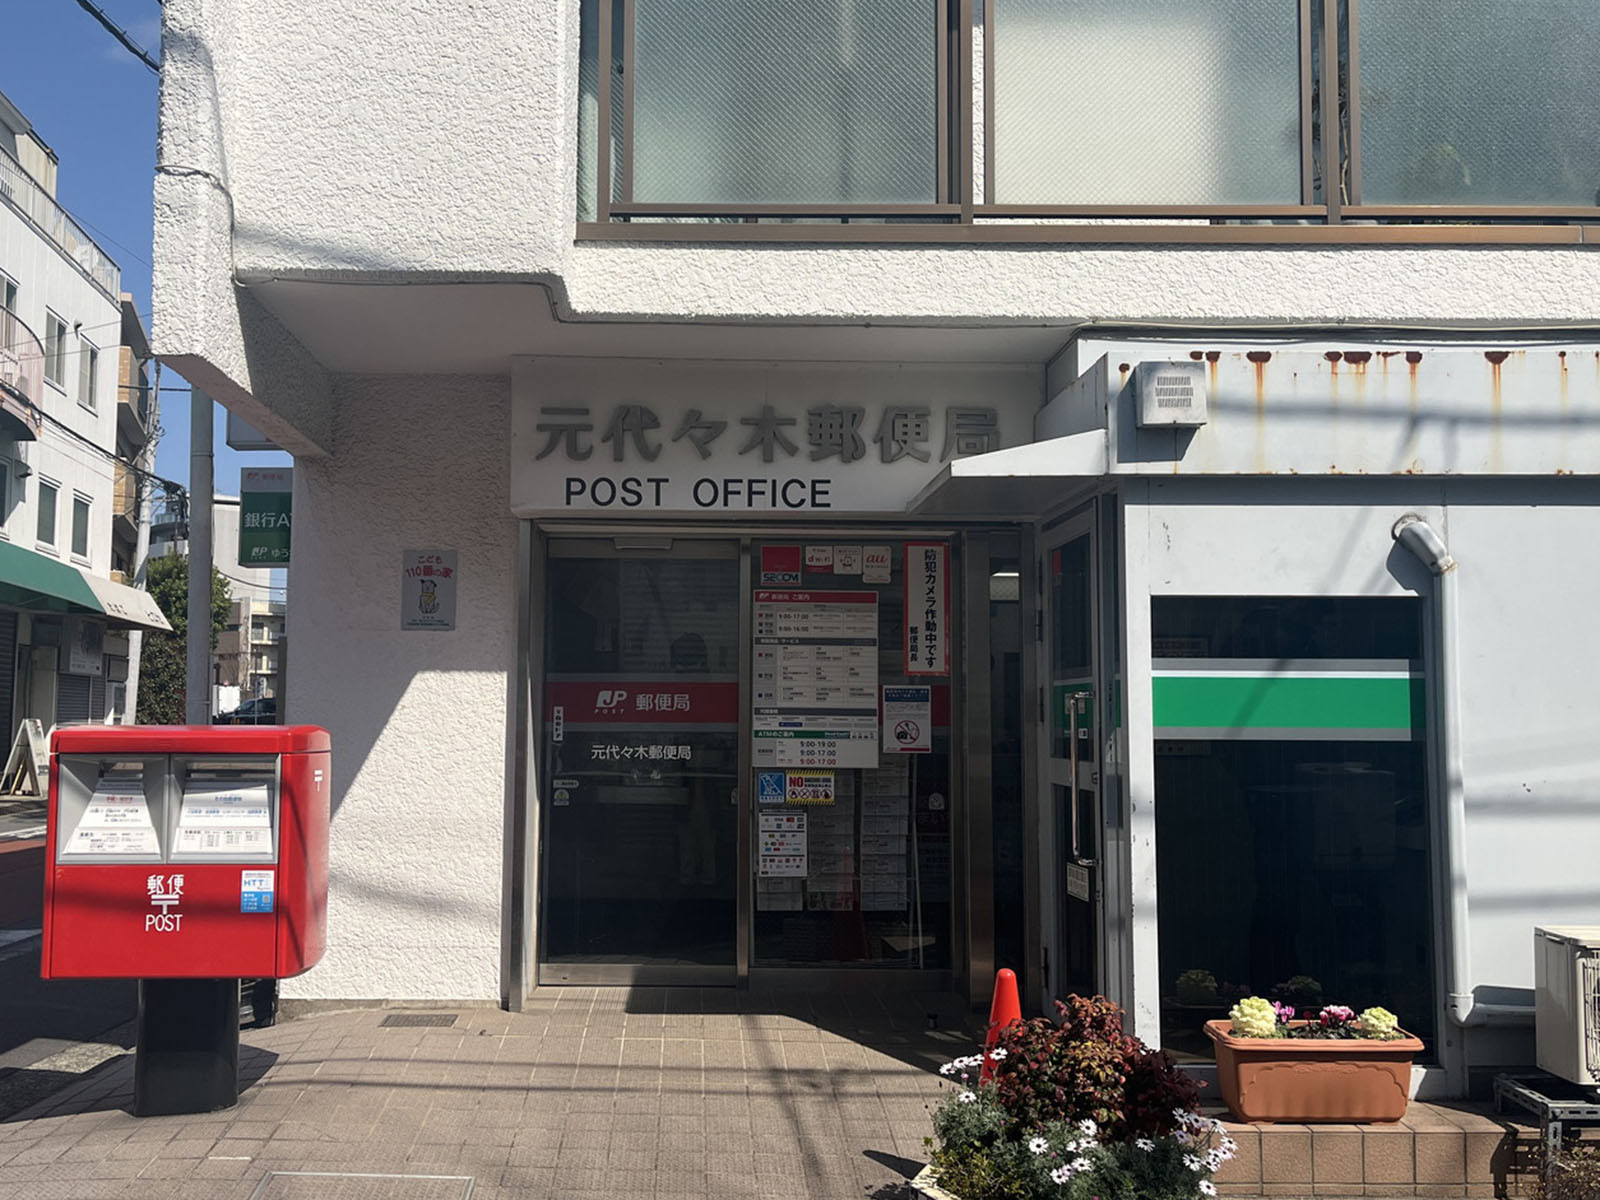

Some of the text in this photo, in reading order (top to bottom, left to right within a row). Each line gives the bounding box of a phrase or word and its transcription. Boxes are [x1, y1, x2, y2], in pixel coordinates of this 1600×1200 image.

[535, 404, 1000, 464] 元代々木郵便局
[565, 477, 832, 508] POST OFFICE
[244, 512, 291, 528] 銀行A
[271, 547, 291, 558] ゆう
[418, 555, 442, 565] こども
[866, 554, 889, 564] au
[763, 573, 799, 582] SECOM
[924, 548, 937, 669] 防犯カメラ作動中です
[635, 693, 691, 712] 郵便局
[591, 744, 692, 761] 元代々木郵便局
[788, 776, 804, 788] NO
[147, 874, 184, 896] 郵便
[145, 914, 183, 932] POST
